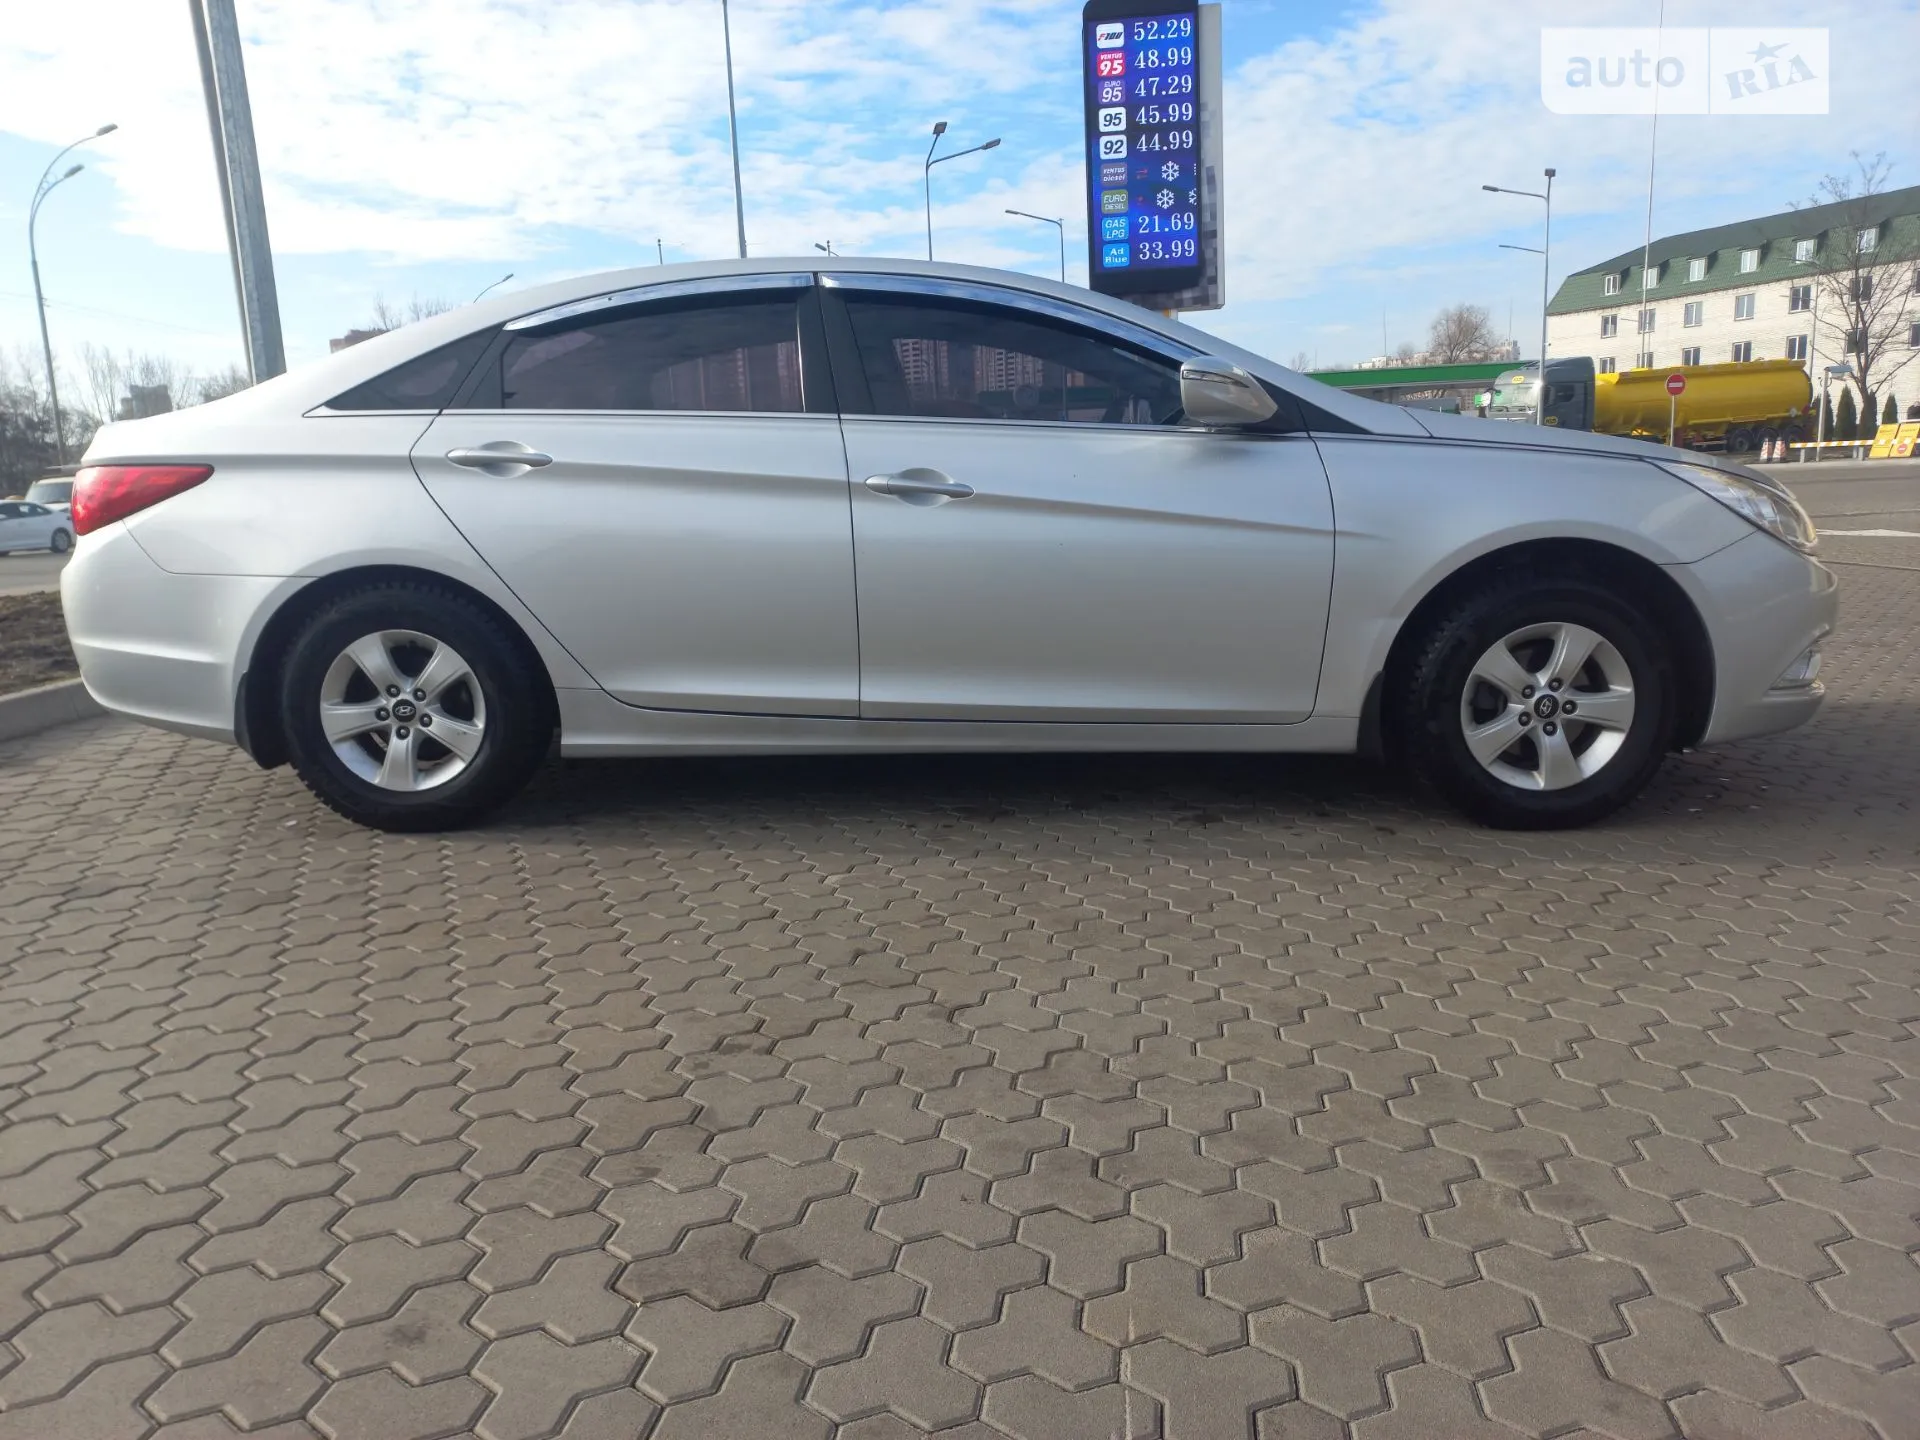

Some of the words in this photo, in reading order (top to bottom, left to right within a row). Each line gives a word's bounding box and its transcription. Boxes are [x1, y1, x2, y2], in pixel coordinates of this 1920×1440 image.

[1134, 18, 1191, 41] 52.29
[1134, 46, 1192, 69] 48.99
[1100, 60, 1123, 76] 95
[1104, 80, 1121, 88] EURO
[1135, 74, 1192, 97] 47.29
[1102, 87, 1122, 102] 95
[1103, 112, 1122, 127] 95
[1135, 102, 1193, 125] 45.99
[1103, 139, 1124, 155] 92
[1136, 129, 1193, 152] 44.99
[1103, 194, 1127, 203] EURO
[1105, 219, 1126, 228] GAS
[1138, 212, 1194, 234] 21.69
[1106, 230, 1125, 239] LPG
[1110, 248, 1124, 256] Ad
[1139, 239, 1195, 260] 33.99
